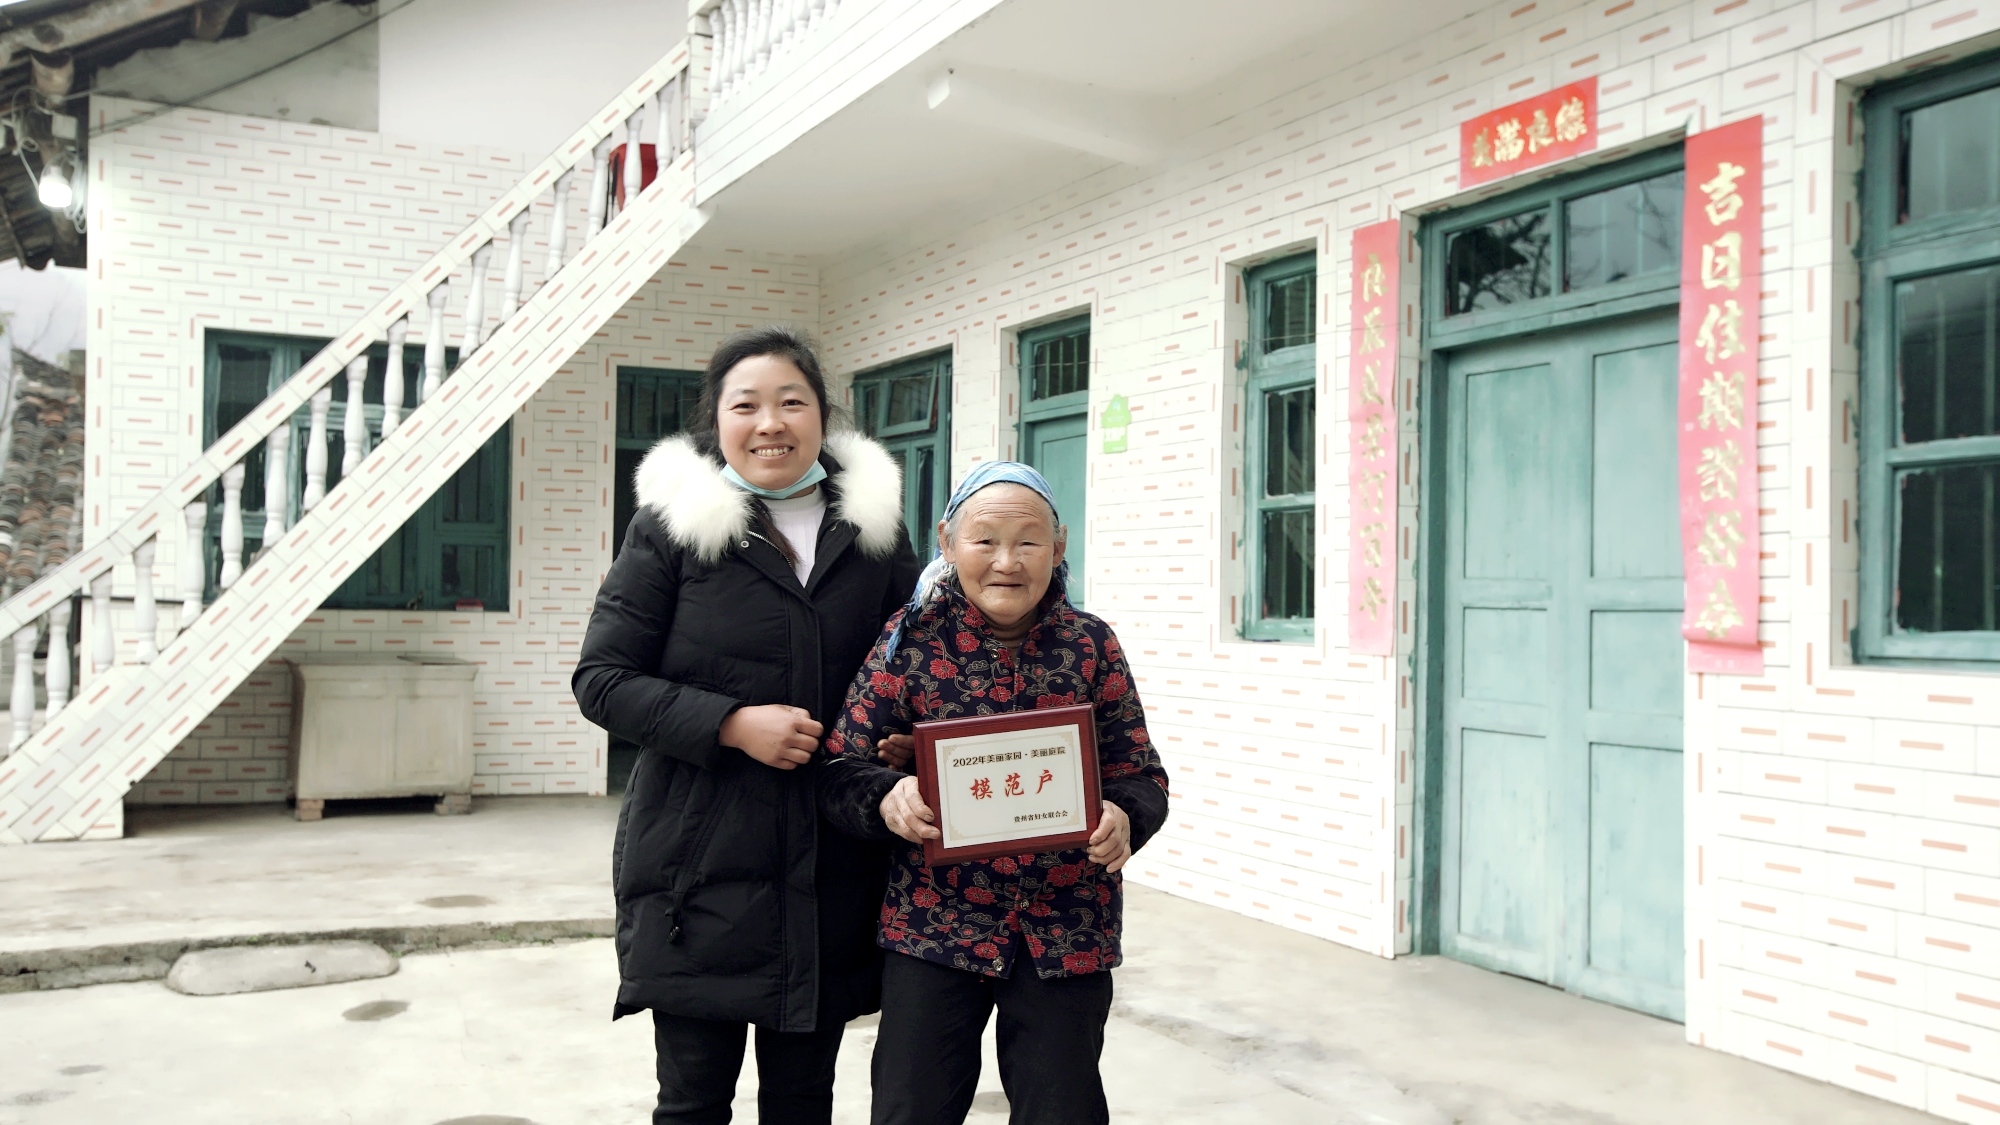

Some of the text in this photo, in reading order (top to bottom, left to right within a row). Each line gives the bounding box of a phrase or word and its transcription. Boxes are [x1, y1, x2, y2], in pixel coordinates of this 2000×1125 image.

[969, 769, 1054, 801] 模范户
[1013, 810, 1069, 823] 贵州省妇女联合会
